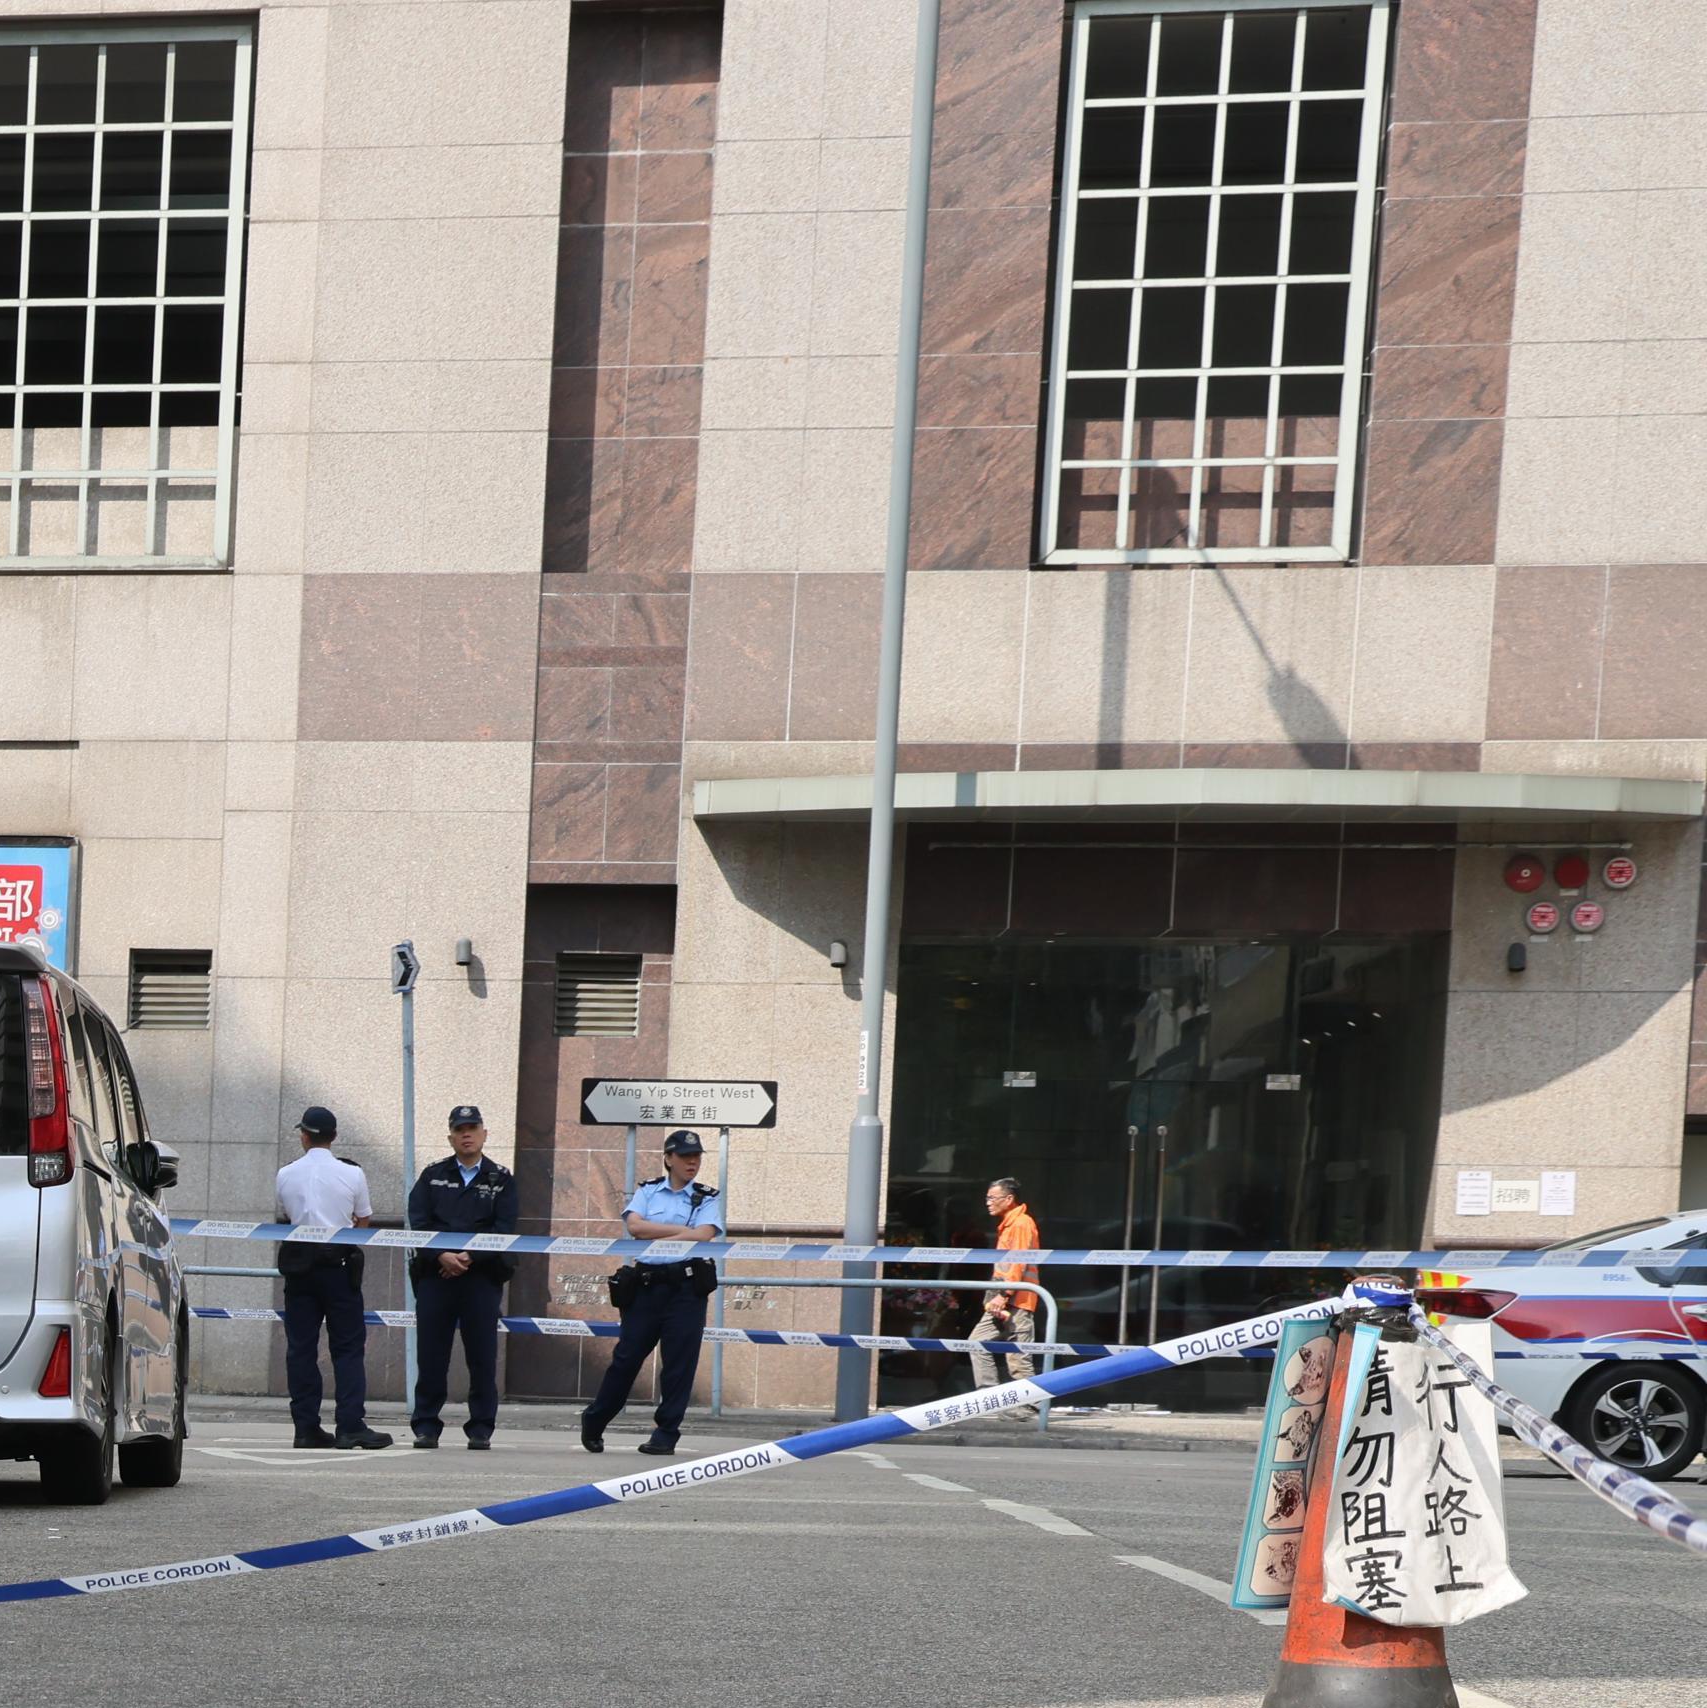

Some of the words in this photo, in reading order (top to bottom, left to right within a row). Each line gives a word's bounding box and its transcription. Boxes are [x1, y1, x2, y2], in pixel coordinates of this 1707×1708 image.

[605, 1085, 642, 1100] Wang
[648, 1086, 668, 1100] Yip
[673, 1086, 714, 1099] Street
[720, 1087, 755, 1099] West
[639, 1105, 718, 1120] 宏業西街
[1177, 1327, 1248, 1361] POLICE
[619, 1469, 688, 1498] POLICE
[1415, 1361, 1484, 1594] 行人路上
[85, 1573, 150, 1590] POLICE
